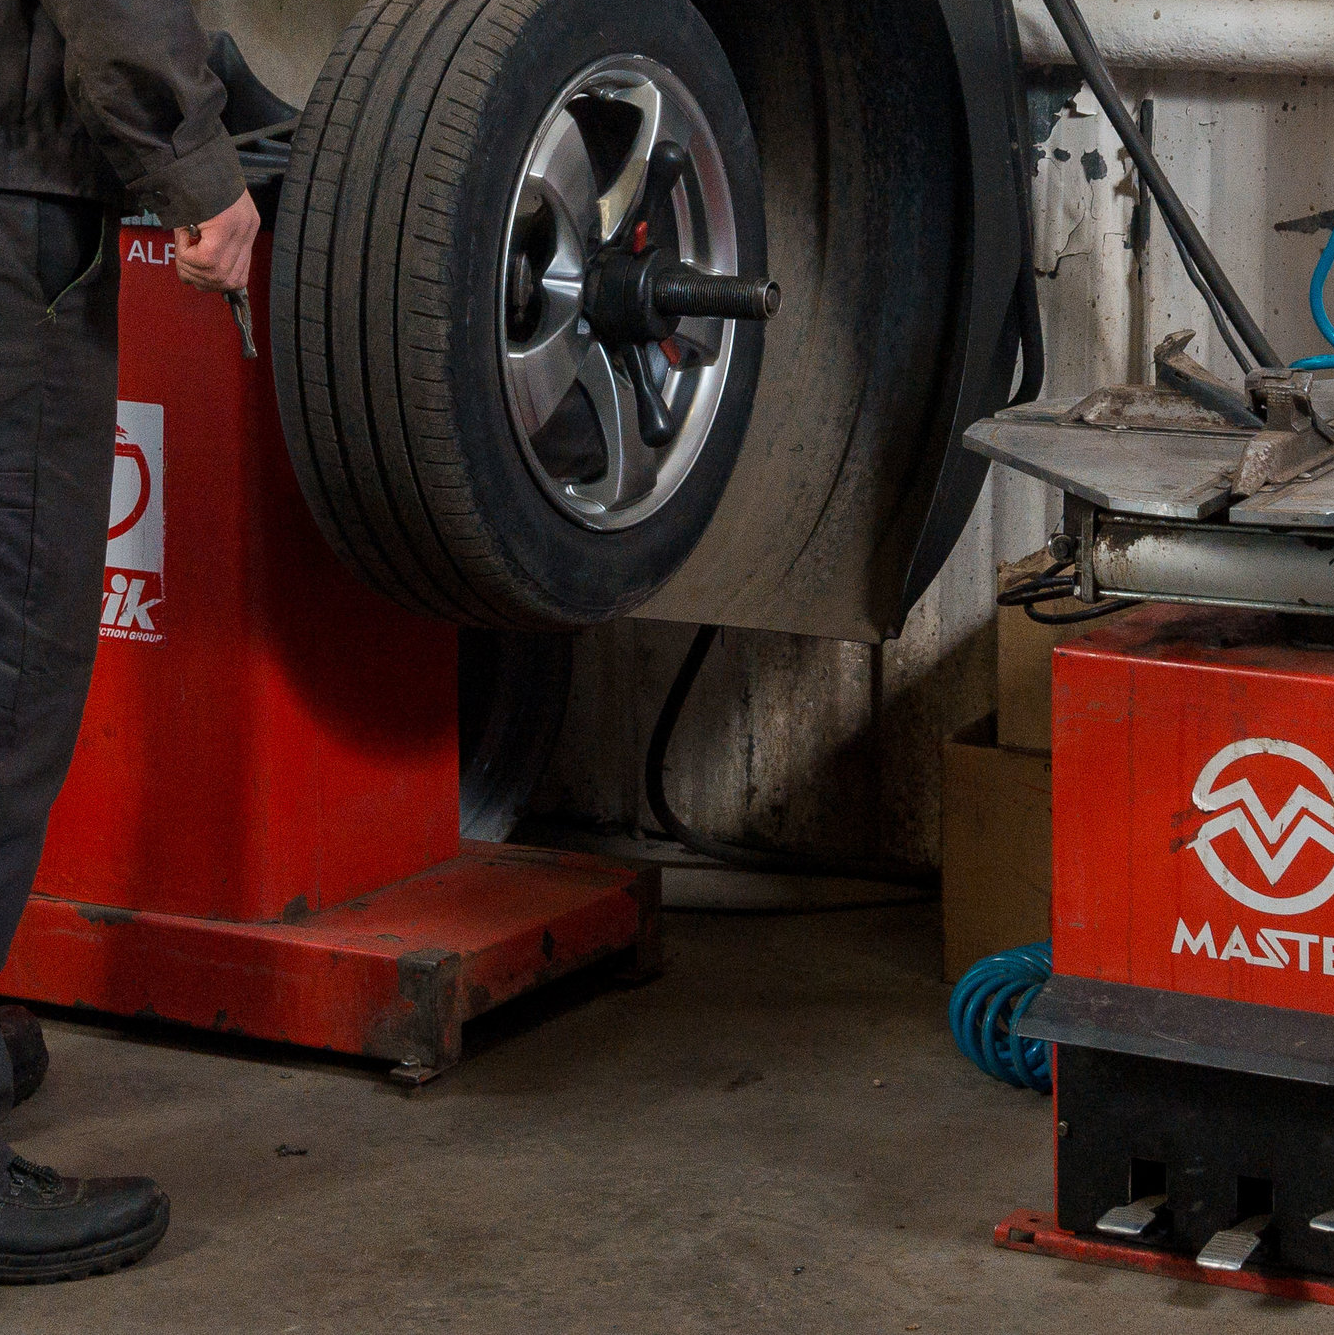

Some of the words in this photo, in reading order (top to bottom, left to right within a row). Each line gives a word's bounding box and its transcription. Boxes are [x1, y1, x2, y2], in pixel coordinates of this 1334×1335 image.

[101, 574, 163, 630] ik
[98, 627, 128, 639] CTION
[129, 631, 163, 643] GROUP
